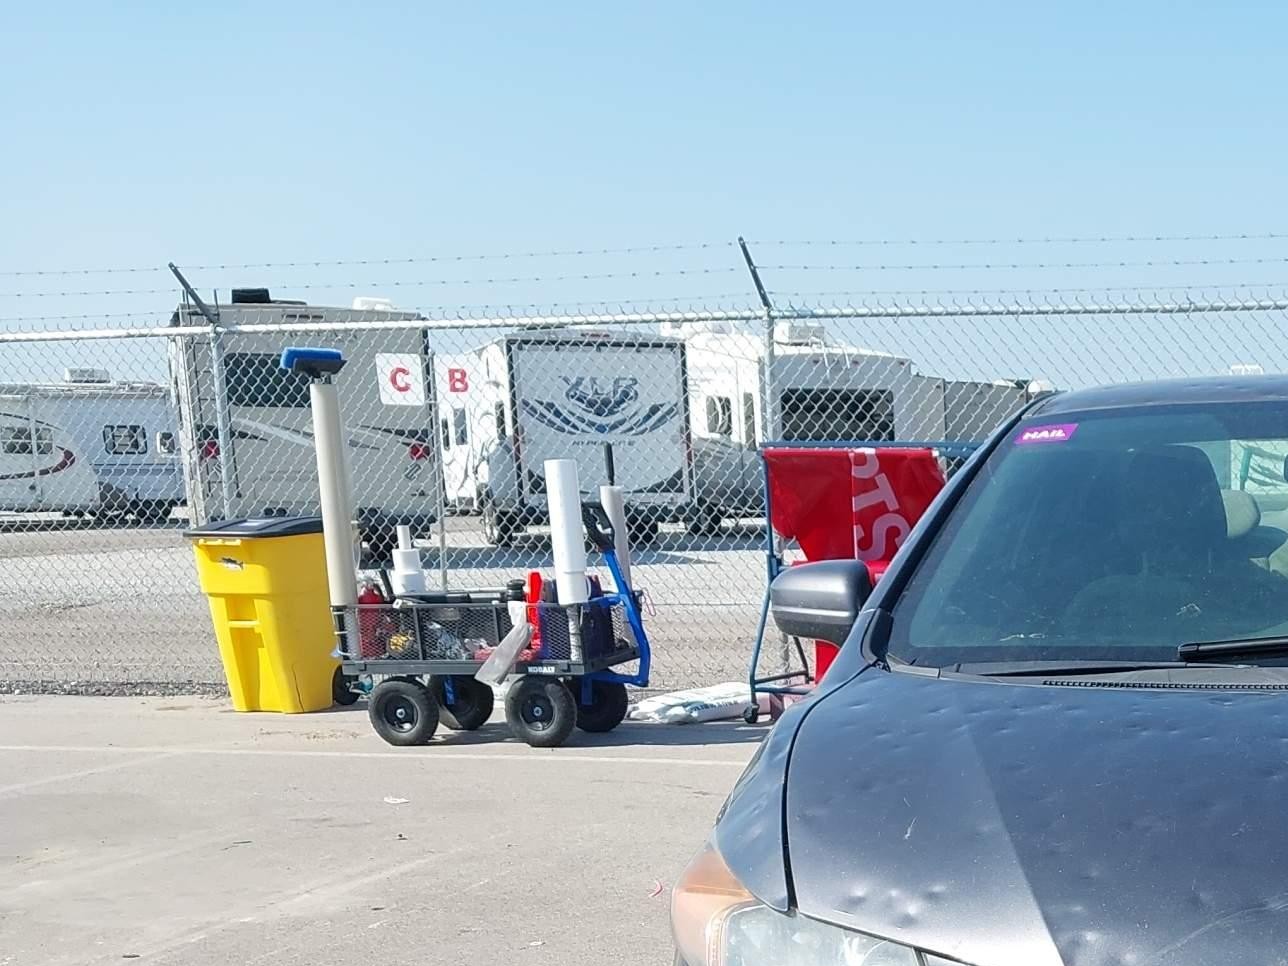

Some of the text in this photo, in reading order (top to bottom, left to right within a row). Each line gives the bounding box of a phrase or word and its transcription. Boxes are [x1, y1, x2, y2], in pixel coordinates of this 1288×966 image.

[389, 367, 411, 392] C
[448, 368, 469, 393] B
[1022, 428, 1066, 441] HAIL
